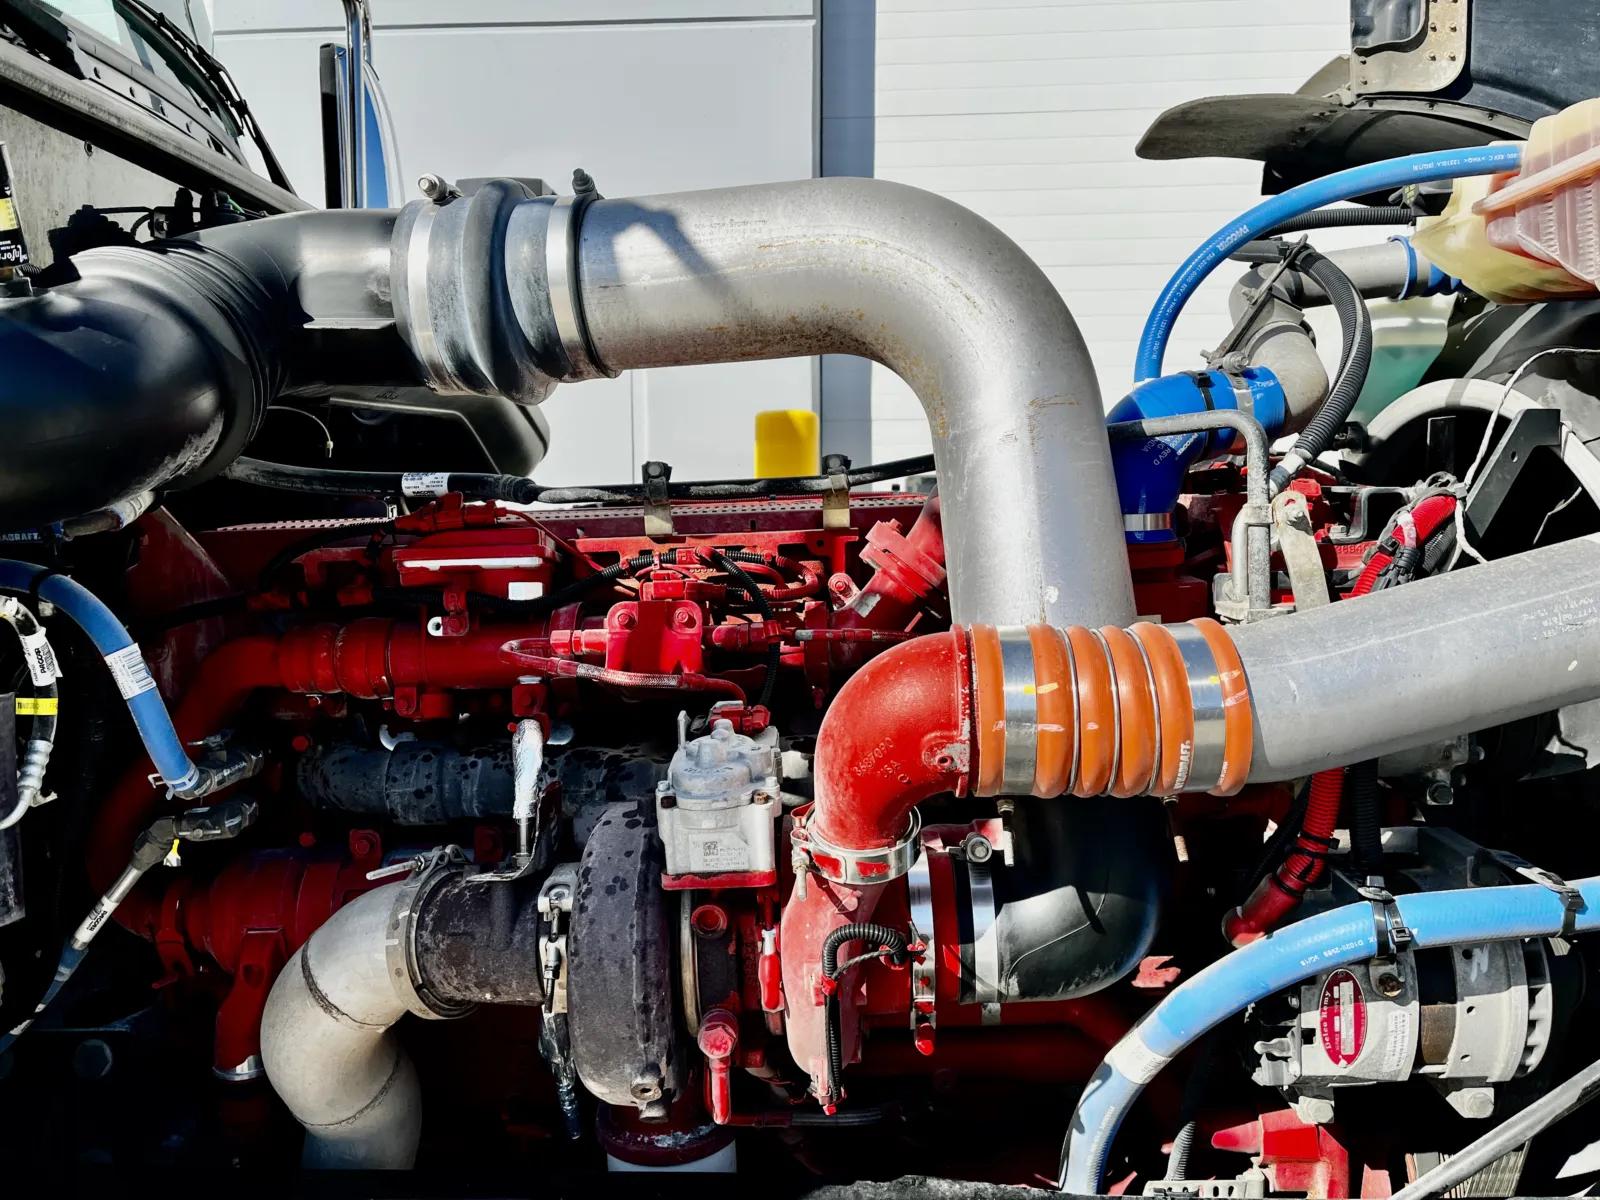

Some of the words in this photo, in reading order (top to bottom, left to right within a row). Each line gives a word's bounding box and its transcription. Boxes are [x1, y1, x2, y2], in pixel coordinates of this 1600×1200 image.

[35, 648, 47, 674] PACCAR
[88, 910, 108, 932] PACCAR
[1321, 990, 1332, 1019] Remy
[1322, 1020, 1332, 1050] Delco
